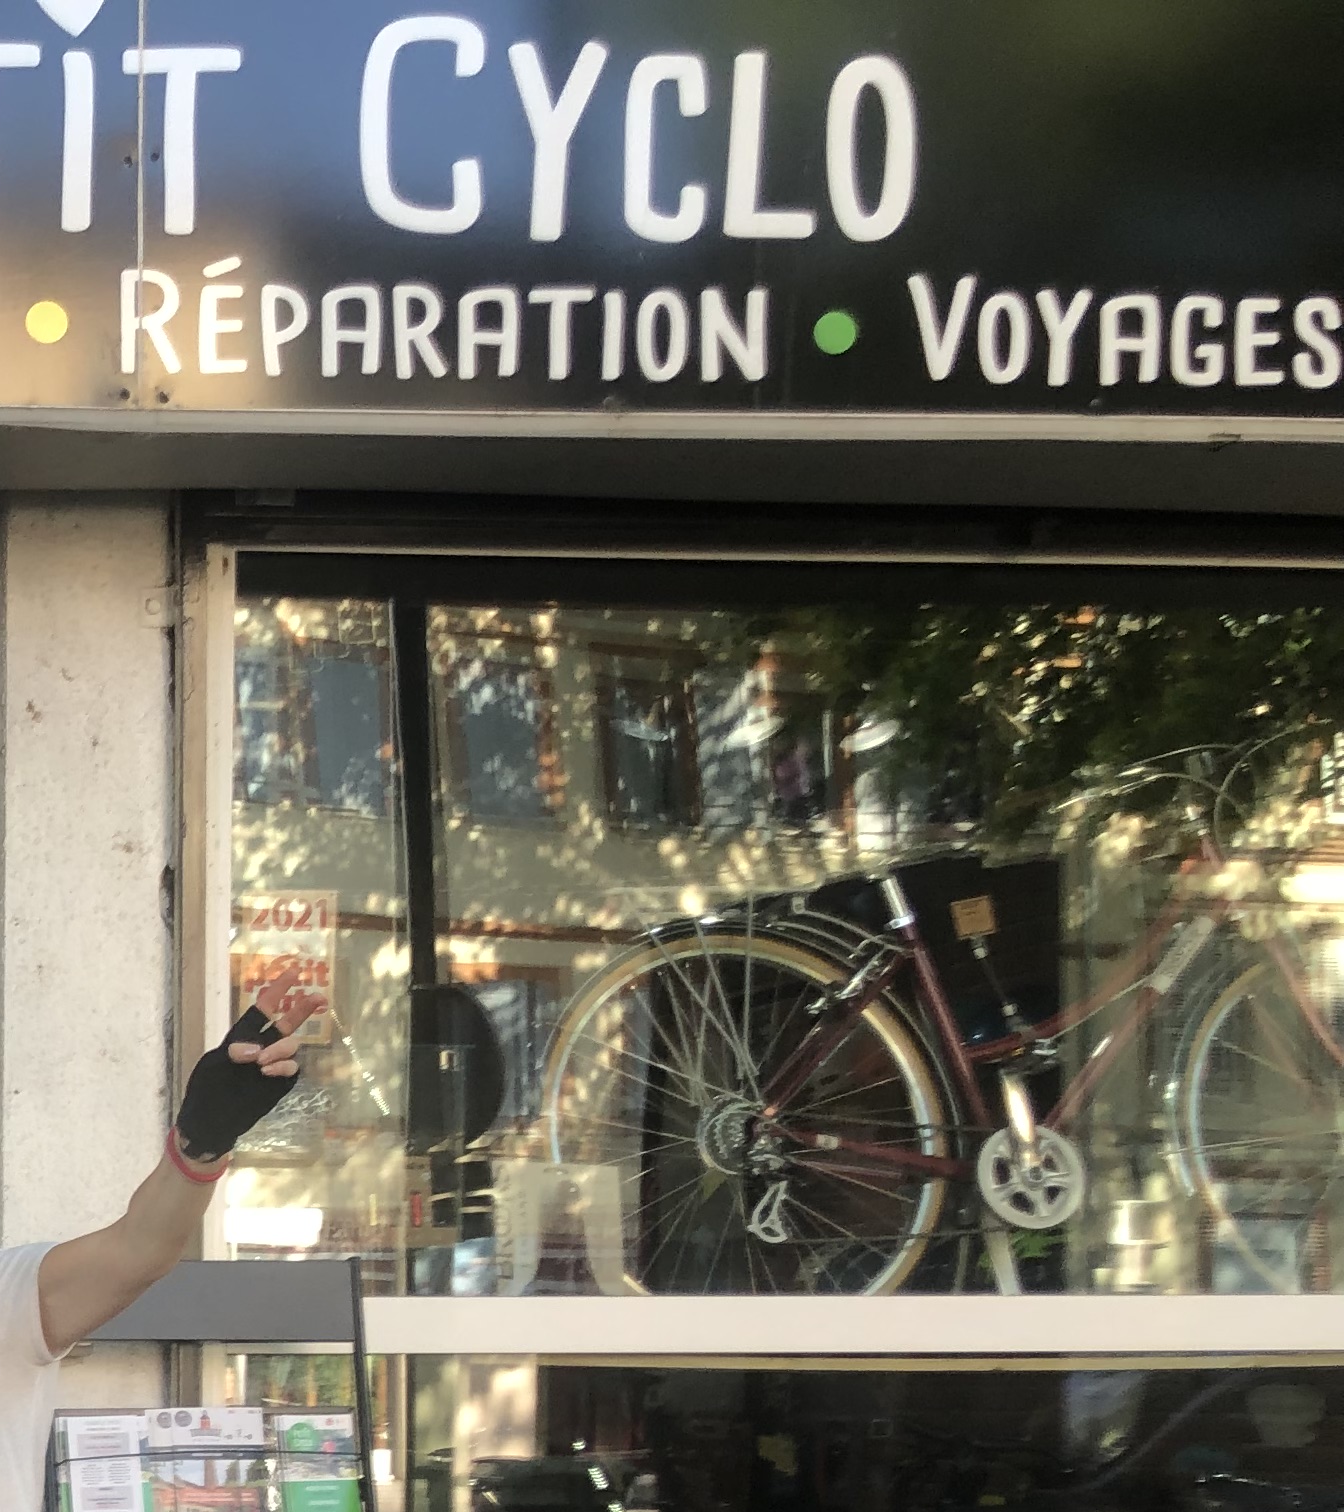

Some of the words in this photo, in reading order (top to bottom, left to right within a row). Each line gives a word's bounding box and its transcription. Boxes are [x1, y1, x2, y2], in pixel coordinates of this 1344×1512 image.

[358, 13, 918, 245] CYCLO
[119, 255, 769, 385] RÉPARATION
[907, 272, 1343, 391] VOYAGES
